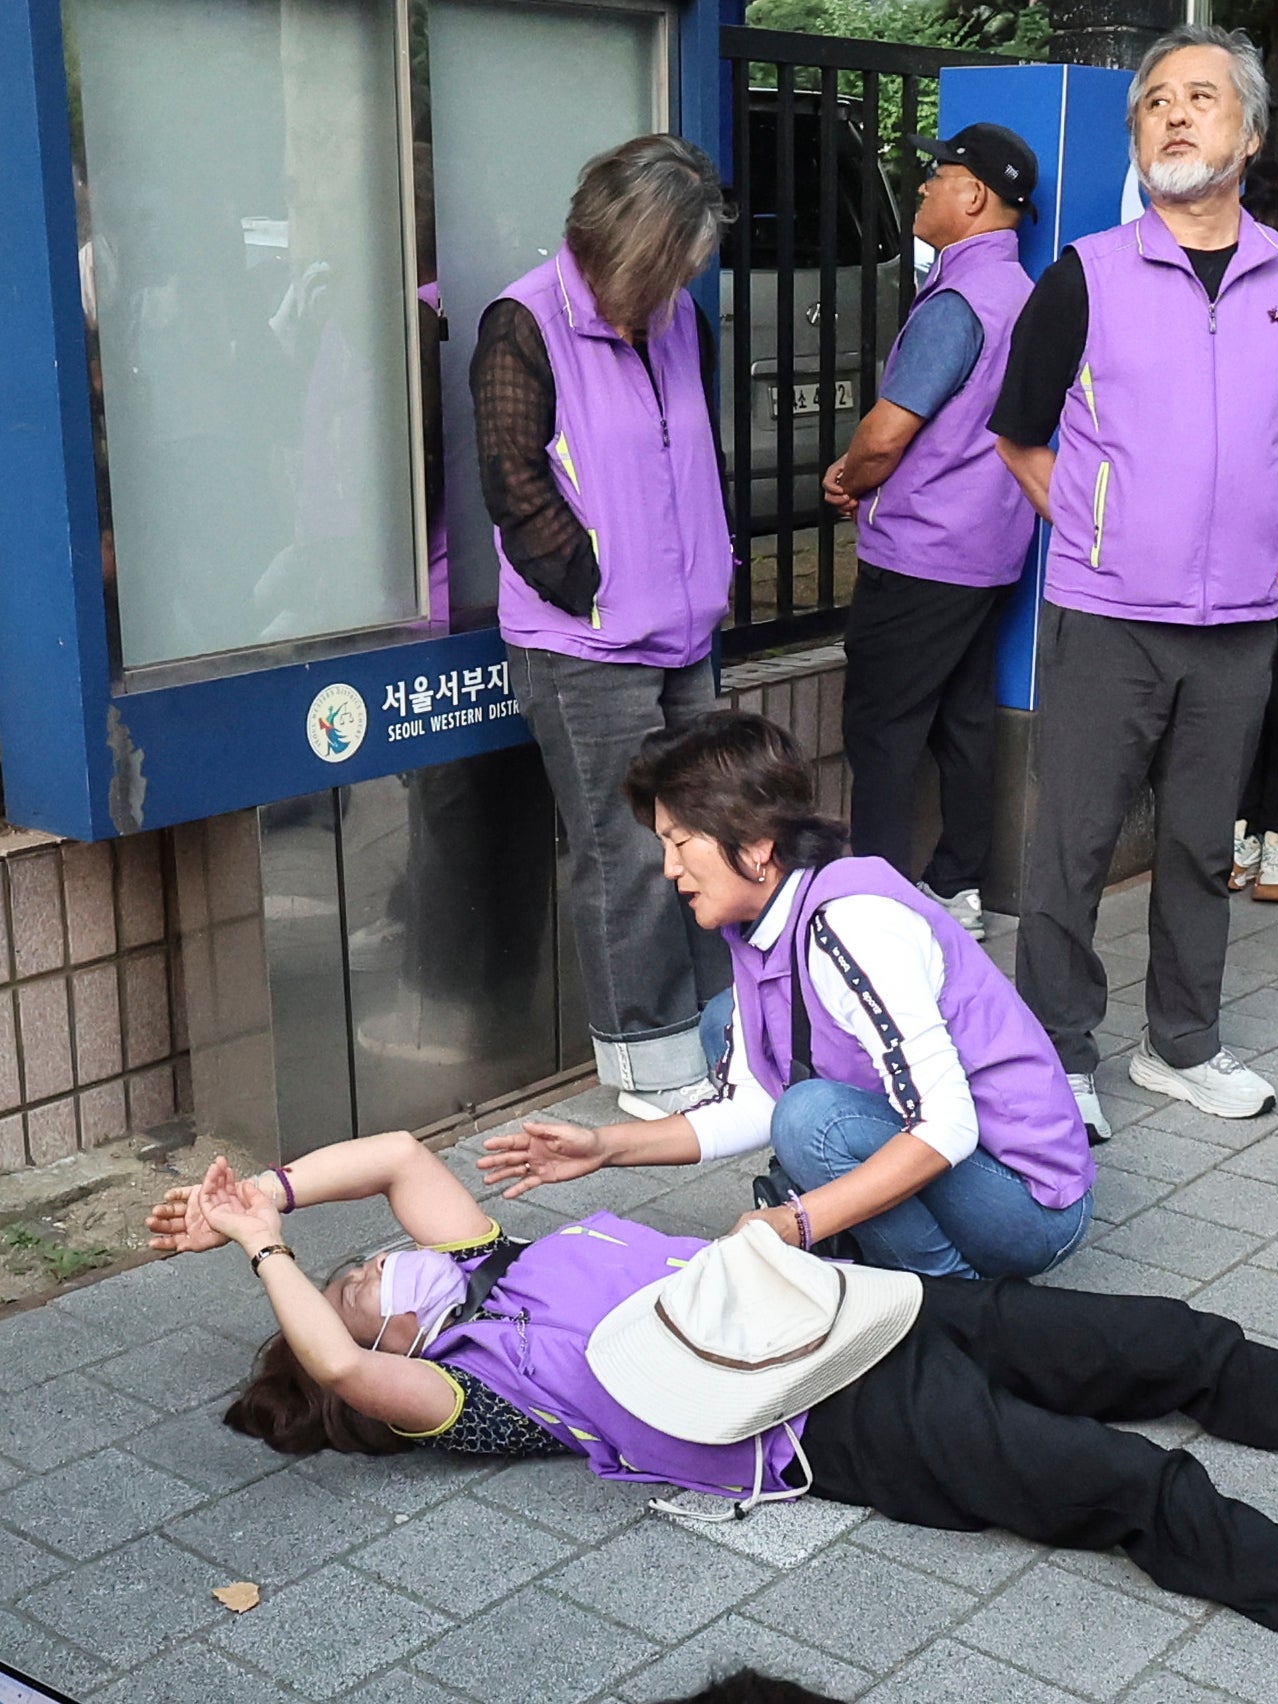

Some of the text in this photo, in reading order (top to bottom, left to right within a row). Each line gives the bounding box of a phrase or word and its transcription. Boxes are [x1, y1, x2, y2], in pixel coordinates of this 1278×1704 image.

[381, 661, 509, 717] 서울서부지
[388, 719, 425, 742] SEOUL
[430, 707, 483, 732] WESTERN
